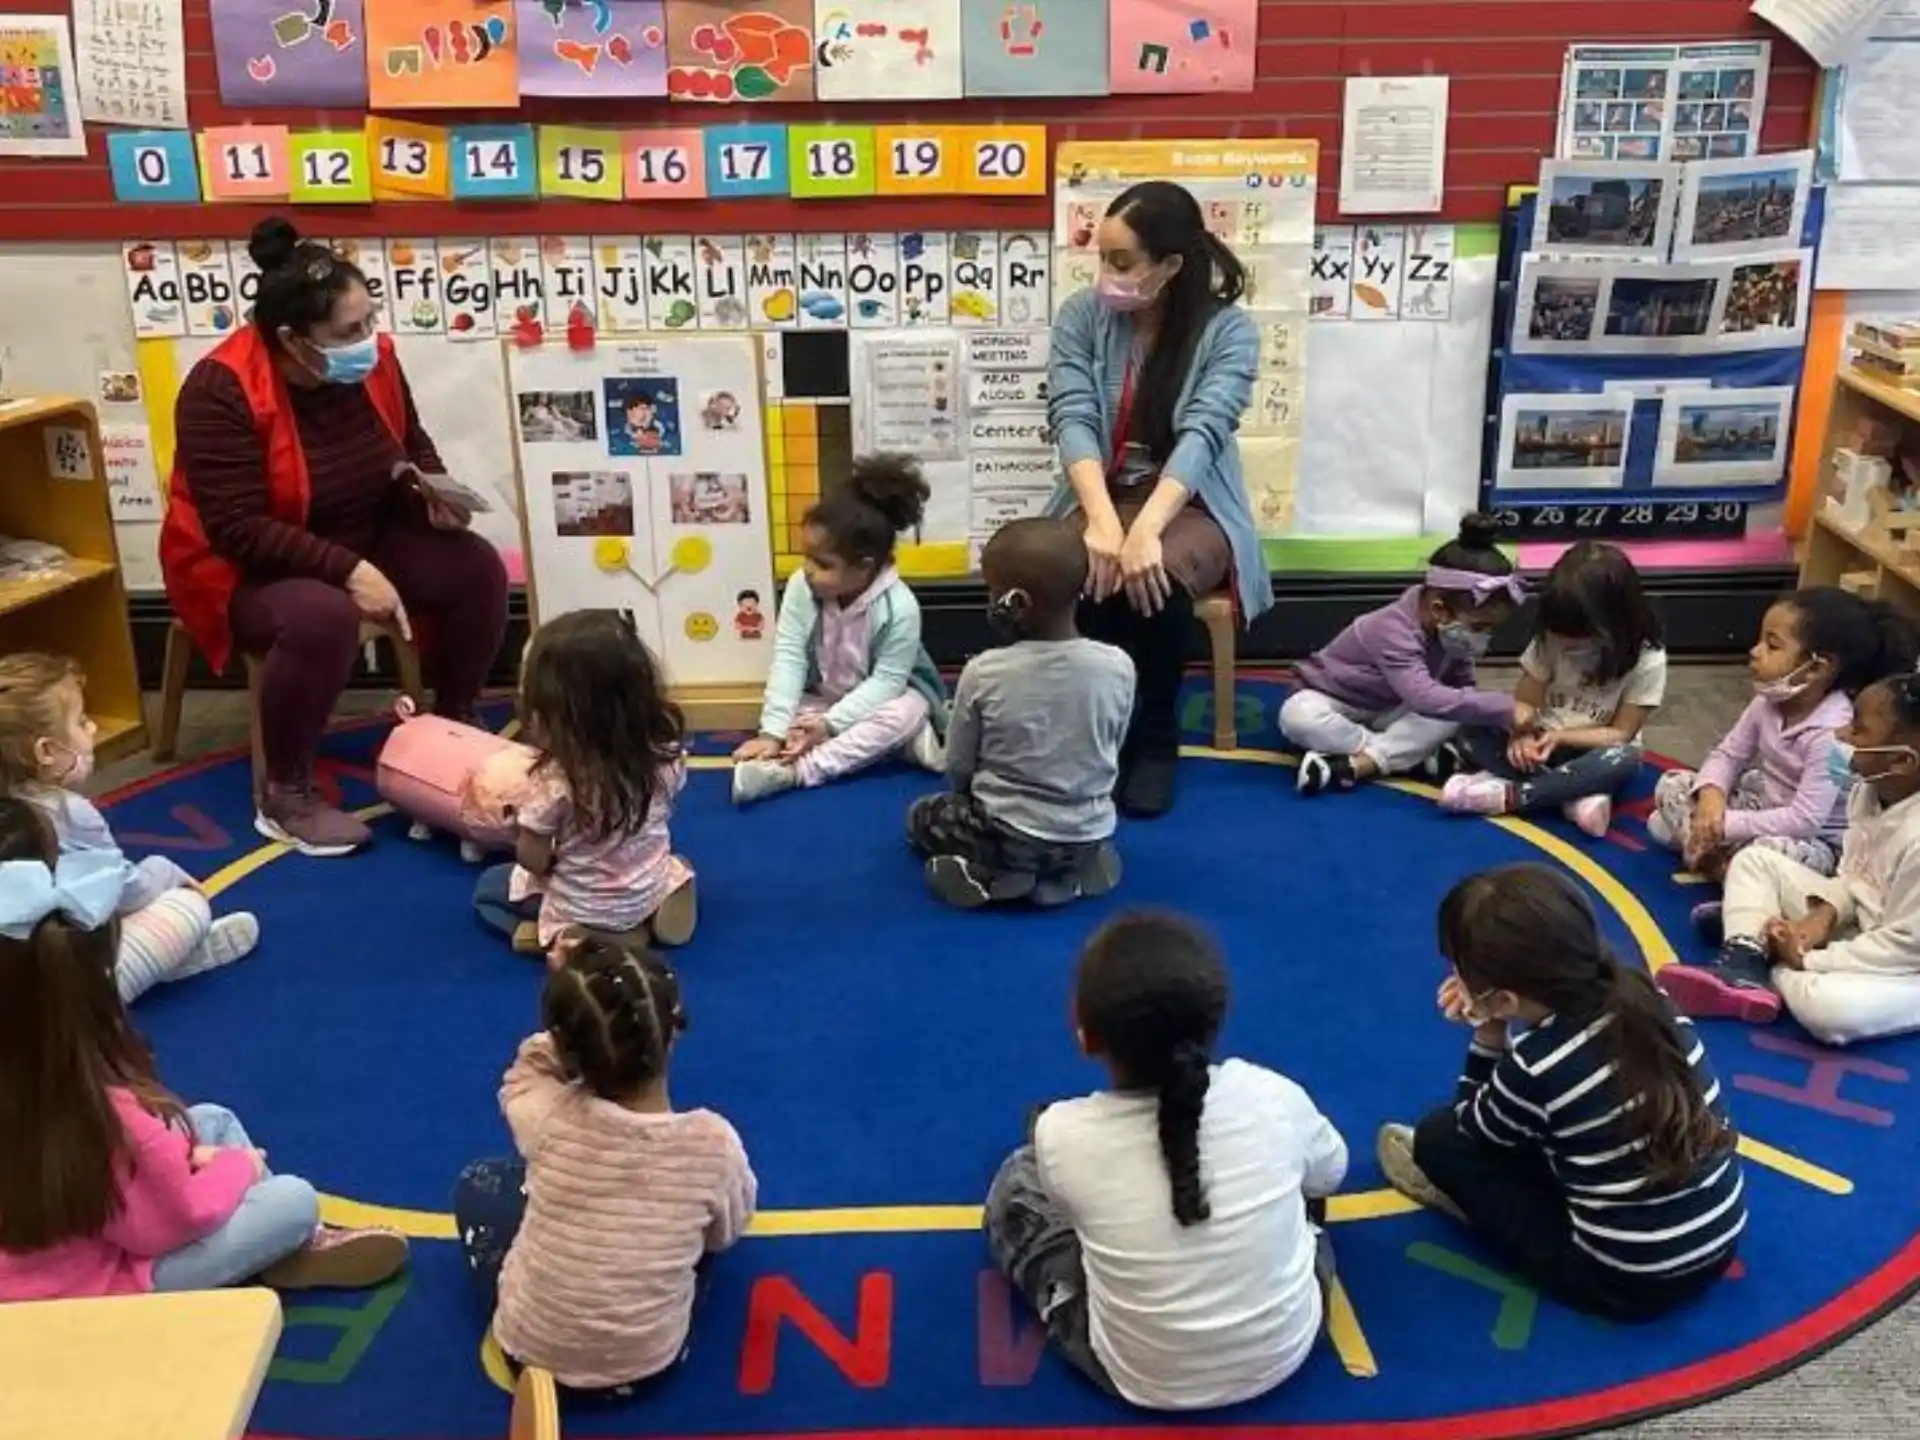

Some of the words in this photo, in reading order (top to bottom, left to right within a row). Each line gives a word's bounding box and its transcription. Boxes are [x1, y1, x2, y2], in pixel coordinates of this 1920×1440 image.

[139, 149, 165, 183] 0
[227, 145, 271, 180] 11
[305, 152, 352, 186] 12
[381, 138, 427, 175] 13
[467, 142, 517, 177] 14
[559, 147, 605, 183] 15
[640, 149, 686, 184] 16
[722, 145, 767, 181] 17
[809, 142, 855, 177] 18
[894, 142, 939, 175] 19
[977, 143, 1026, 177] 20
[554, 267, 586, 296] Ii
[650, 264, 692, 295] Kk
[707, 267, 736, 297] Ll
[750, 264, 794, 287] Mm
[801, 263, 843, 290] Nn
[849, 264, 896, 293] Oo
[955, 262, 993, 290] Qq
[1009, 262, 1044, 289] Rr
[1310, 253, 1350, 281] Xx
[1363, 255, 1395, 284] Yy
[1407, 254, 1449, 282] Zz
[133, 274, 180, 302] Aa
[187, 272, 231, 302] Bb
[395, 268, 435, 300] Ff
[446, 274, 490, 313] Gg
[494, 268, 544, 299] Hh
[601, 266, 639, 305] Jj
[905, 264, 943, 302] Pp
[971, 350, 1029, 361] MEETING
[982, 373, 1021, 385] READ
[978, 389, 1026, 401] ALOUD
[1532, 505, 1566, 527] 26
[1575, 504, 1609, 527] 27
[1619, 504, 1654, 525] 28
[1664, 502, 1700, 522] 29
[1705, 501, 1741, 522] 30
[1732, 1032, 1910, 1127] H
[738, 1271, 894, 1395] N
